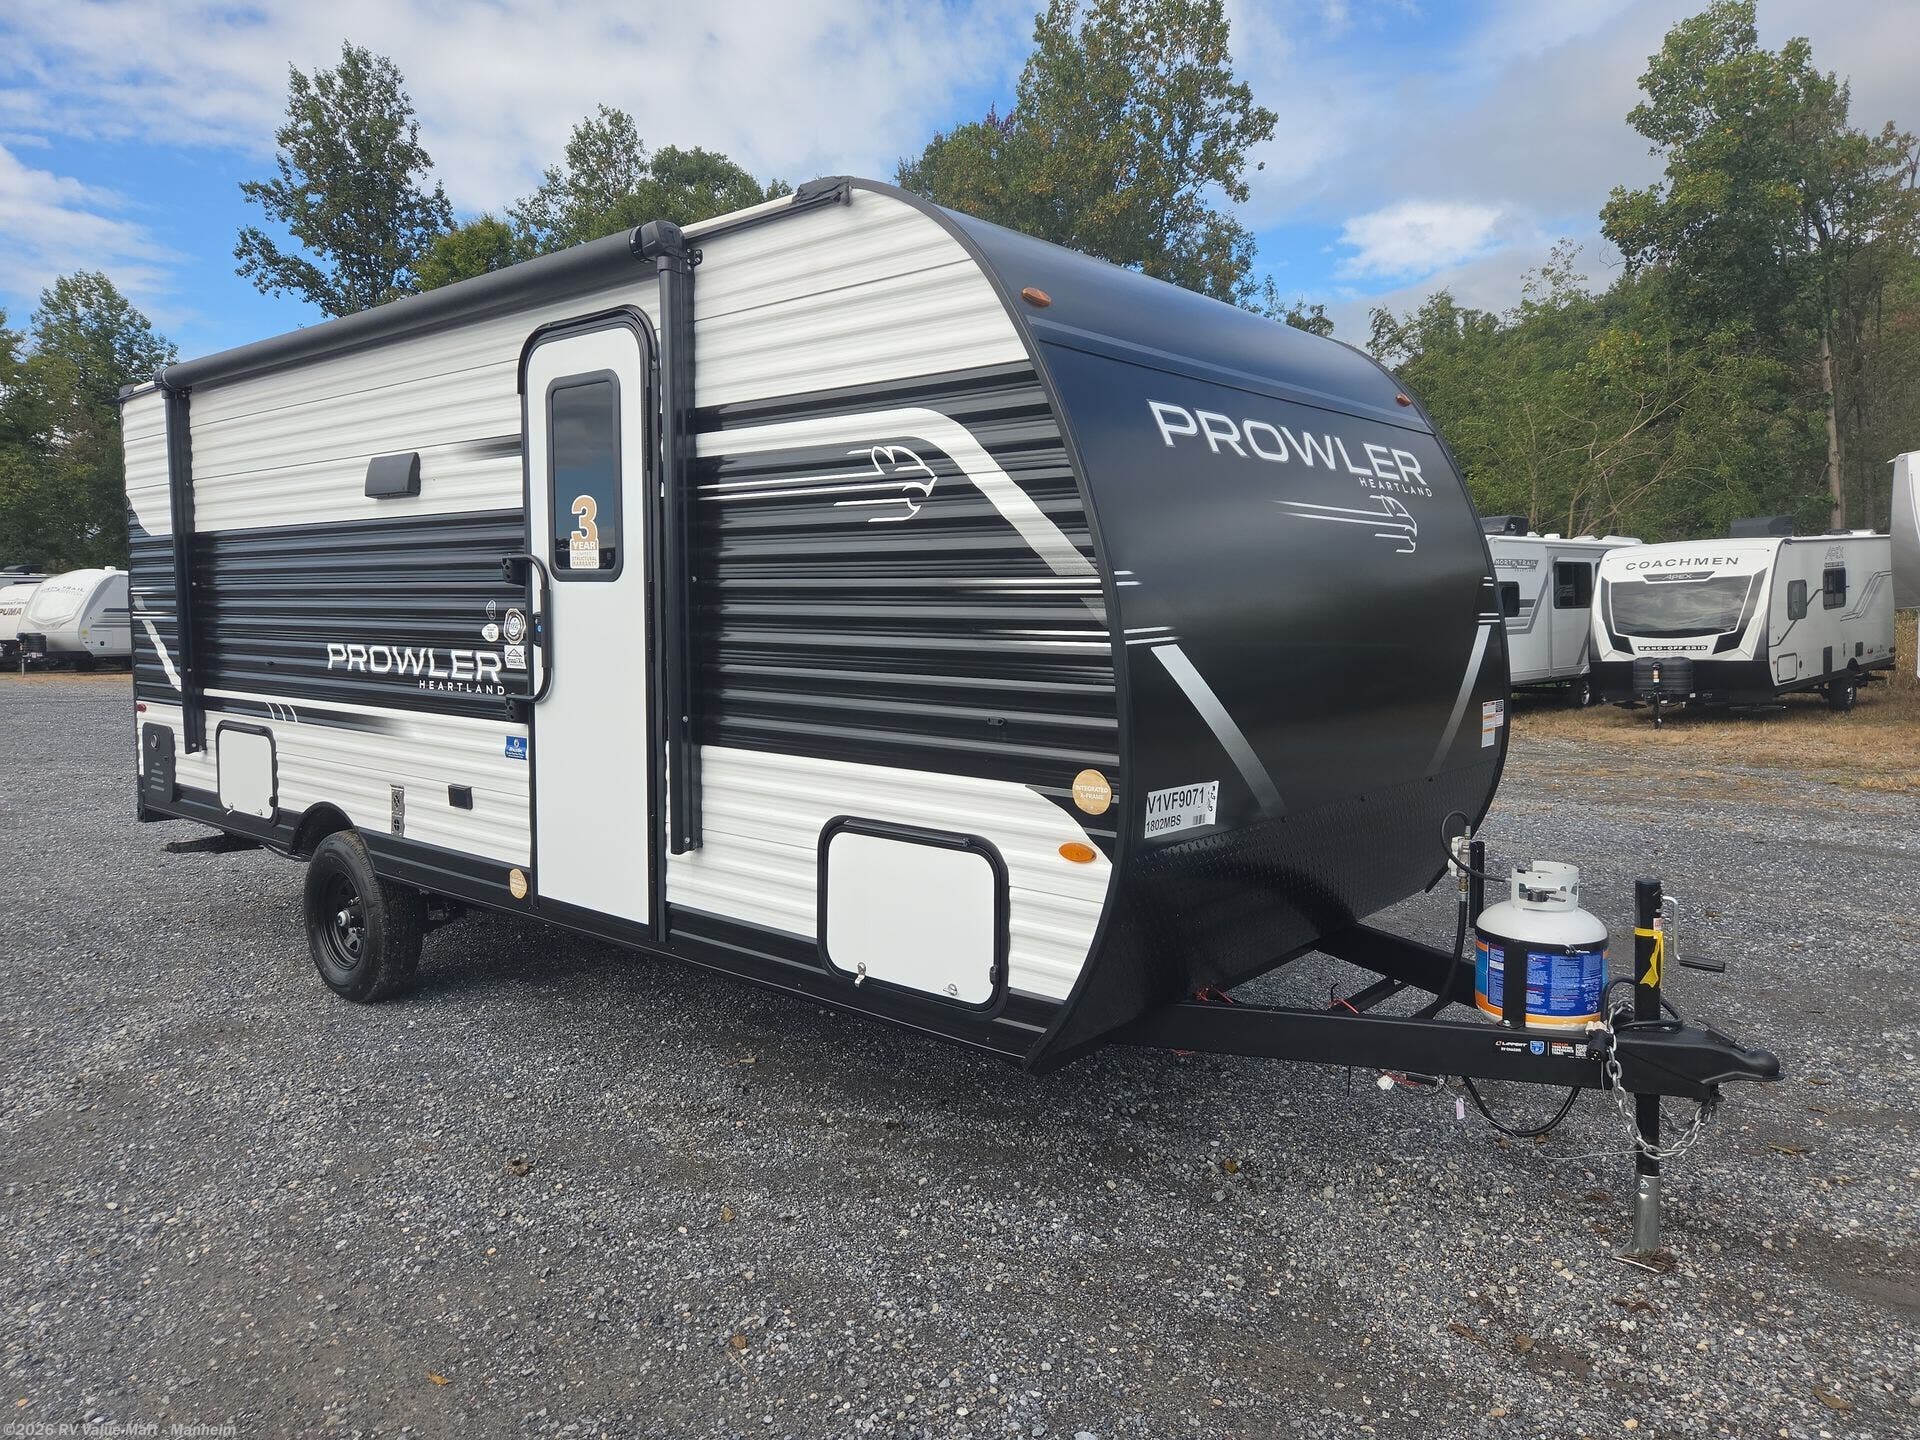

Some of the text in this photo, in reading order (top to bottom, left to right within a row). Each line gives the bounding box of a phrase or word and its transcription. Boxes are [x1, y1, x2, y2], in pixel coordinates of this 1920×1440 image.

[1148, 399, 1427, 485] PROWLER
[1359, 477, 1433, 498] HEARTLAND
[571, 495, 598, 541] 3
[573, 541, 596, 550] YEAR
[1625, 557, 1739, 571] COACHMEN
[327, 643, 503, 682] PROWLER
[419, 680, 505, 695] HEARTLAND
[1147, 787, 1205, 814] V1VF9071
[1146, 815, 1182, 833] 1802MBS
